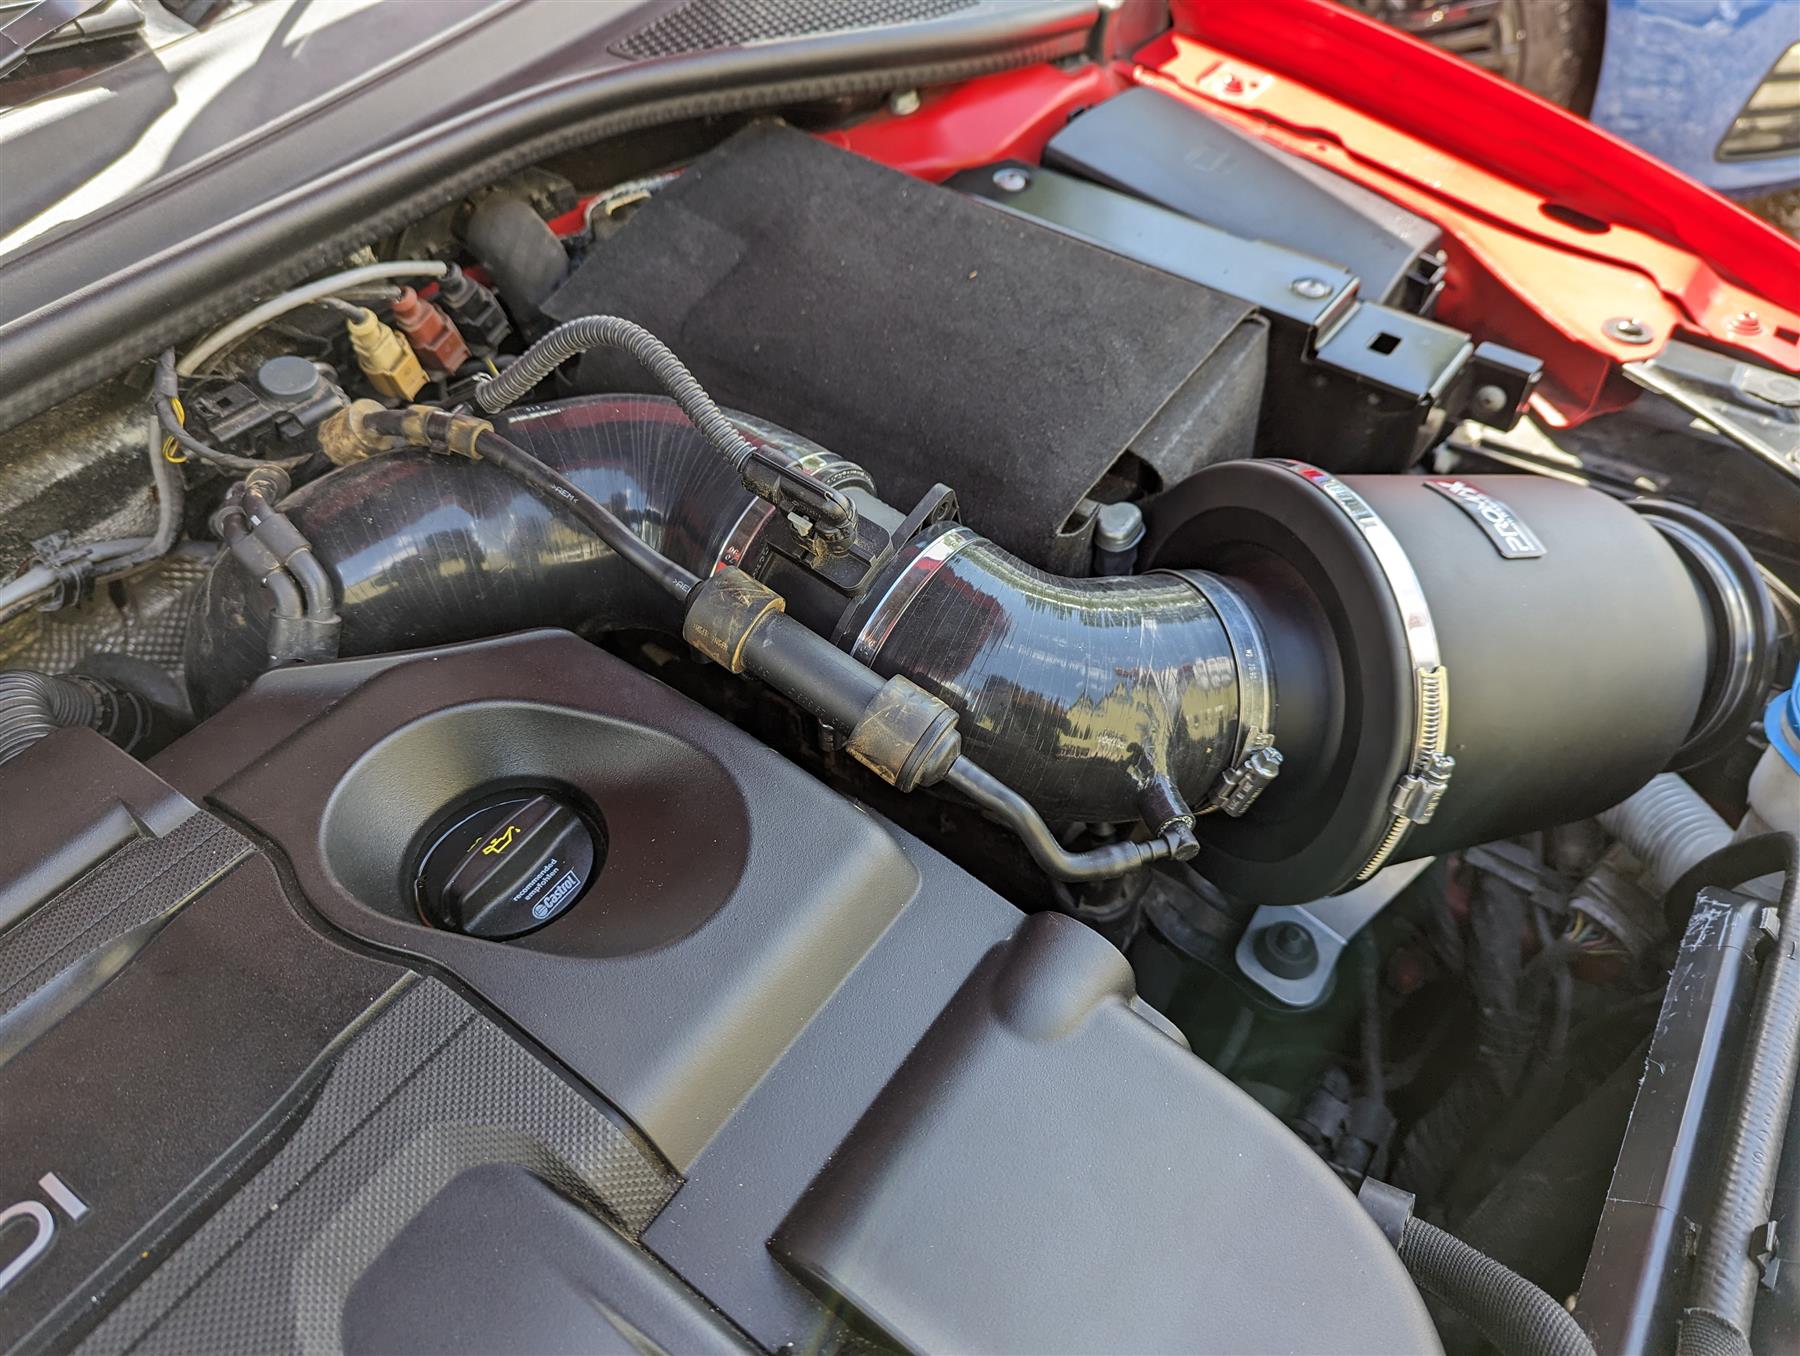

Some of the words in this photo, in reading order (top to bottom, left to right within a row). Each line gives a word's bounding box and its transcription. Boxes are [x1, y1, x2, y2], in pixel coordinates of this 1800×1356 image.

[513, 858, 557, 901] recommended
[525, 867, 559, 900] empfohlen
[543, 875, 577, 909] Castrol
